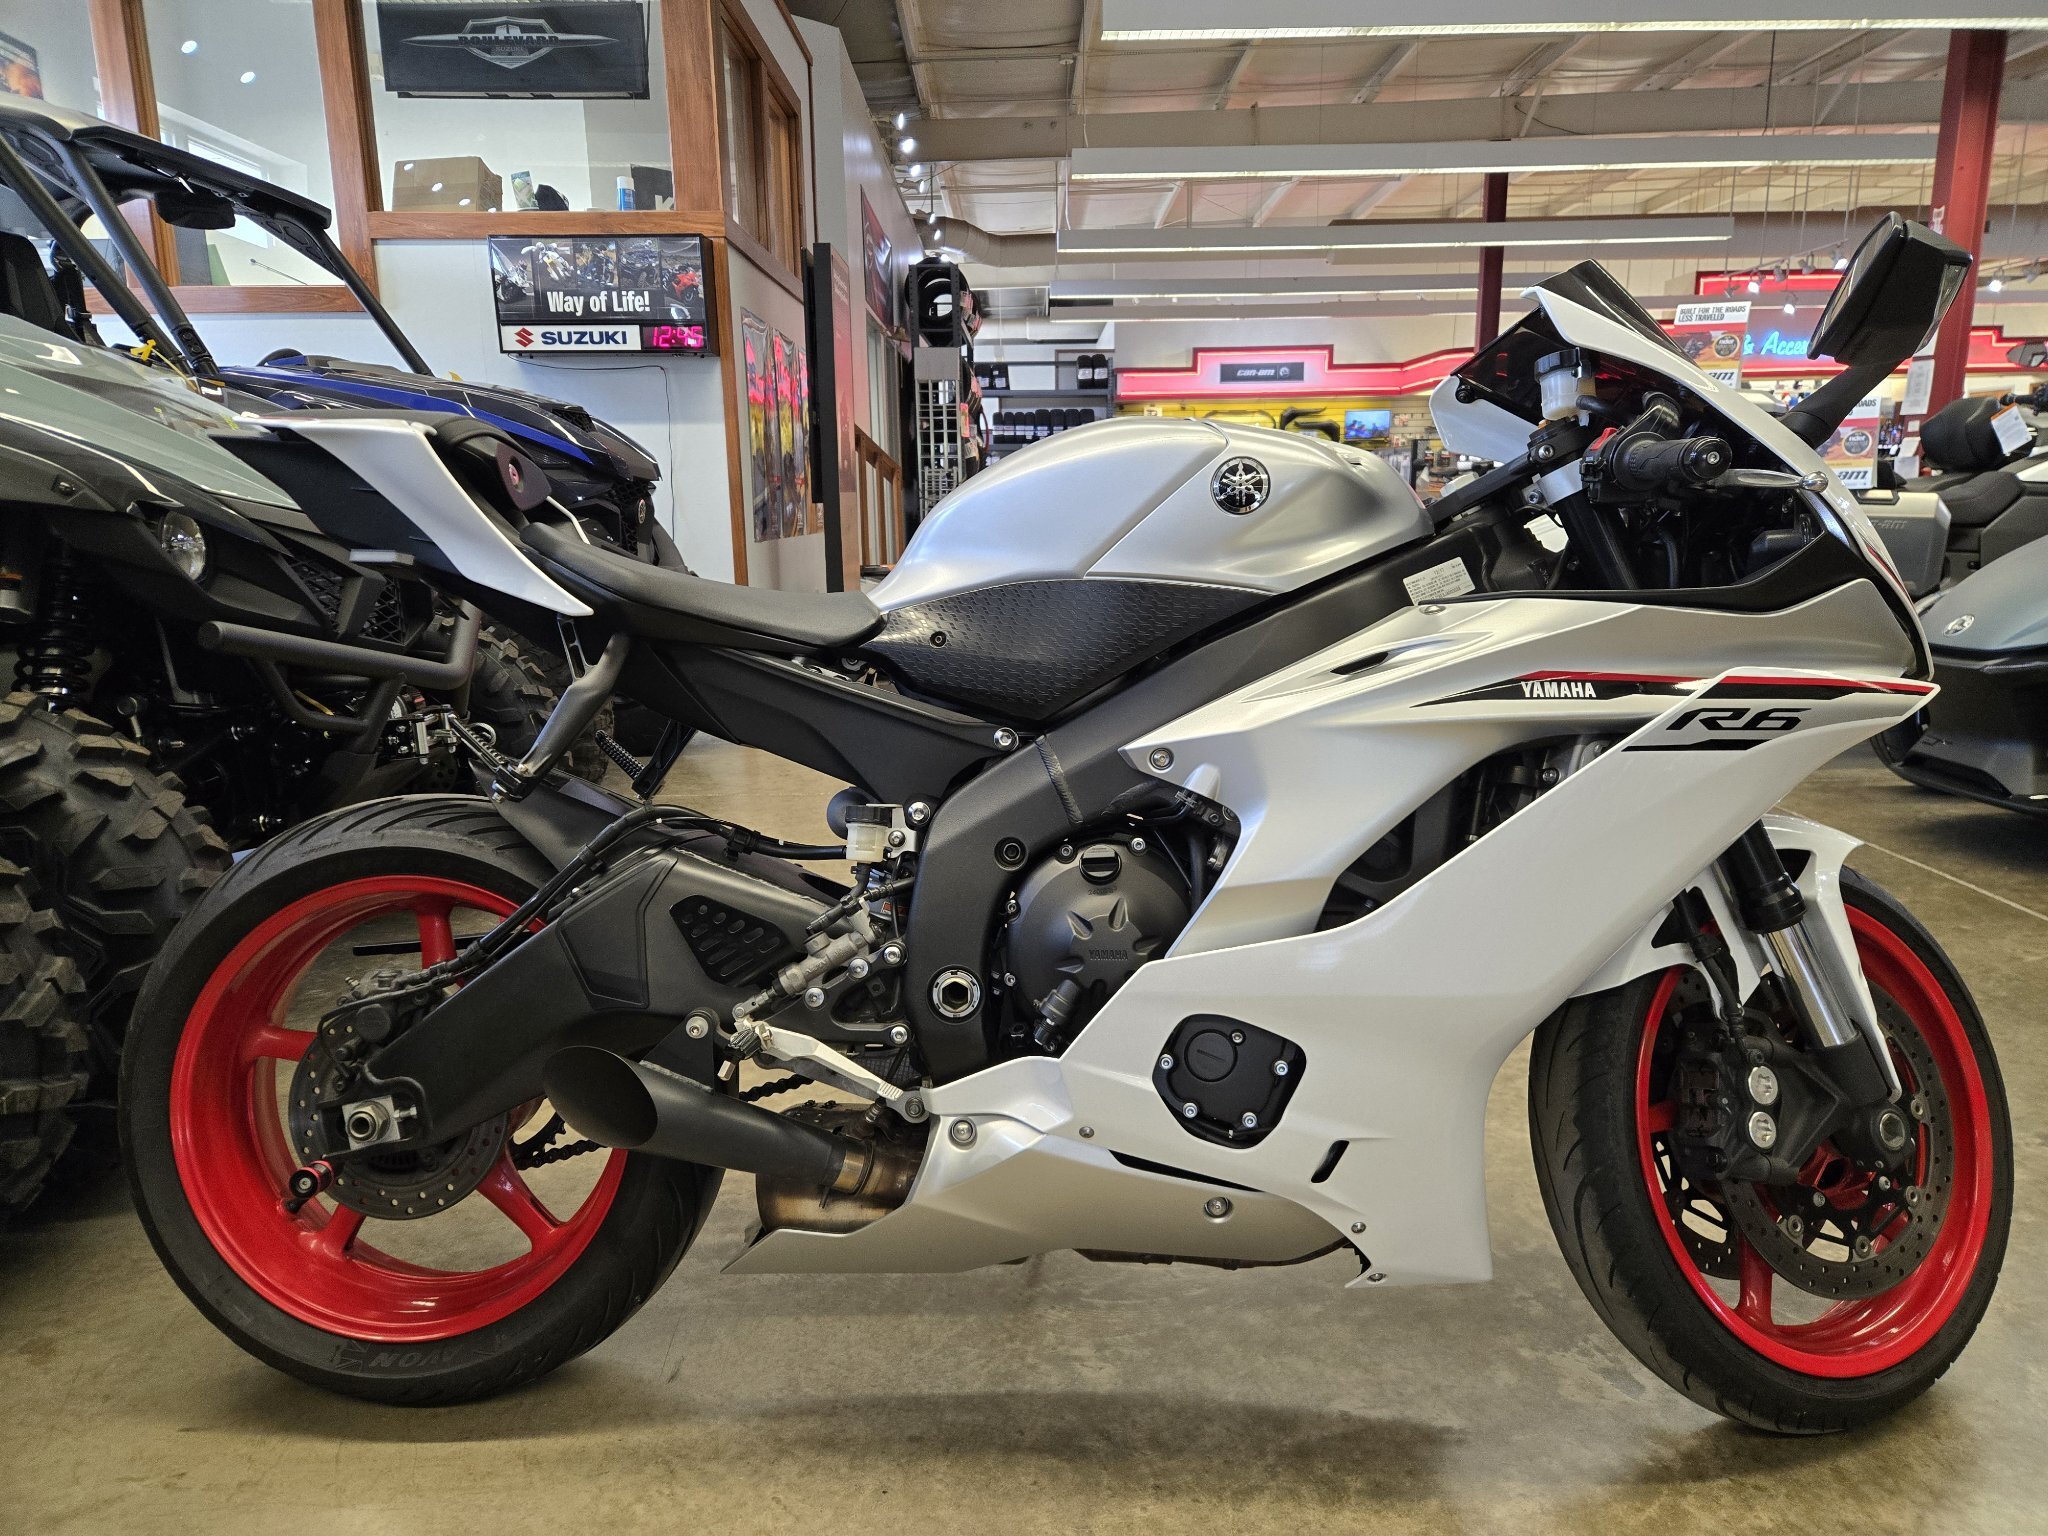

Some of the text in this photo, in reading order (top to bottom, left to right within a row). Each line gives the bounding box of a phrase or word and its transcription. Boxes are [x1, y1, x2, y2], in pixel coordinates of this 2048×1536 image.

[457, 35, 560, 46] BOULEVARD
[546, 290, 651, 317] Way of Life!
[1679, 307, 1697, 315] BUILT
[1724, 305, 1746, 313] ROADS
[1678, 313, 1725, 322] LESS TRAVELED
[541, 330, 627, 345] SUZUKI
[653, 325, 703, 348] 12:45
[1855, 399, 1877, 407] OADS
[1520, 680, 1597, 698] YAMAHA
[1665, 707, 1813, 731] R6
[1088, 949, 1128, 960] YAMAHA
